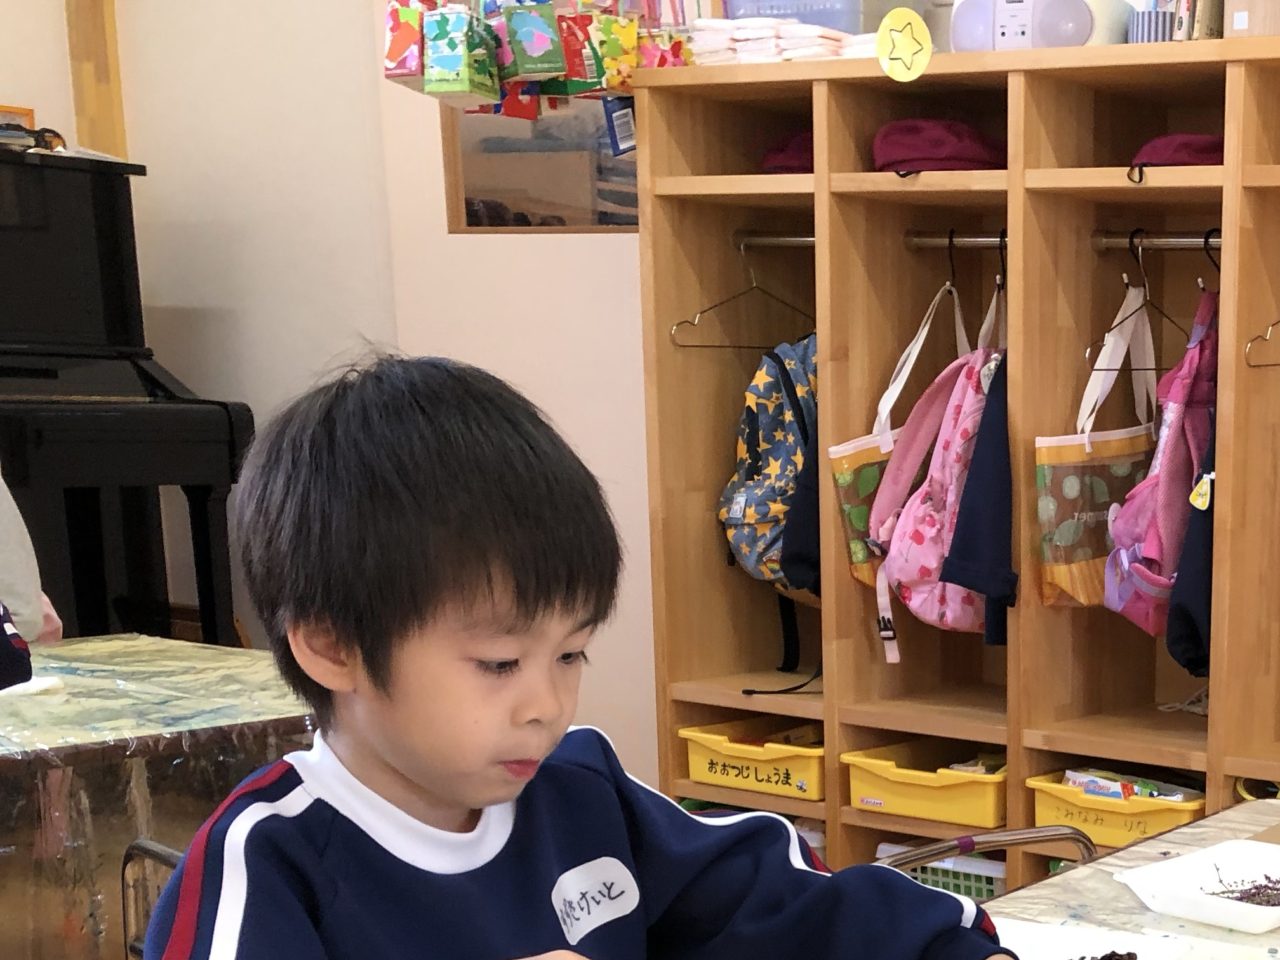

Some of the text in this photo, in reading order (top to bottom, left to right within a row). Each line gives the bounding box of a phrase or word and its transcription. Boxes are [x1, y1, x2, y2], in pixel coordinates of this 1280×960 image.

[707, 758, 792, 787] おおつじ しょうま
